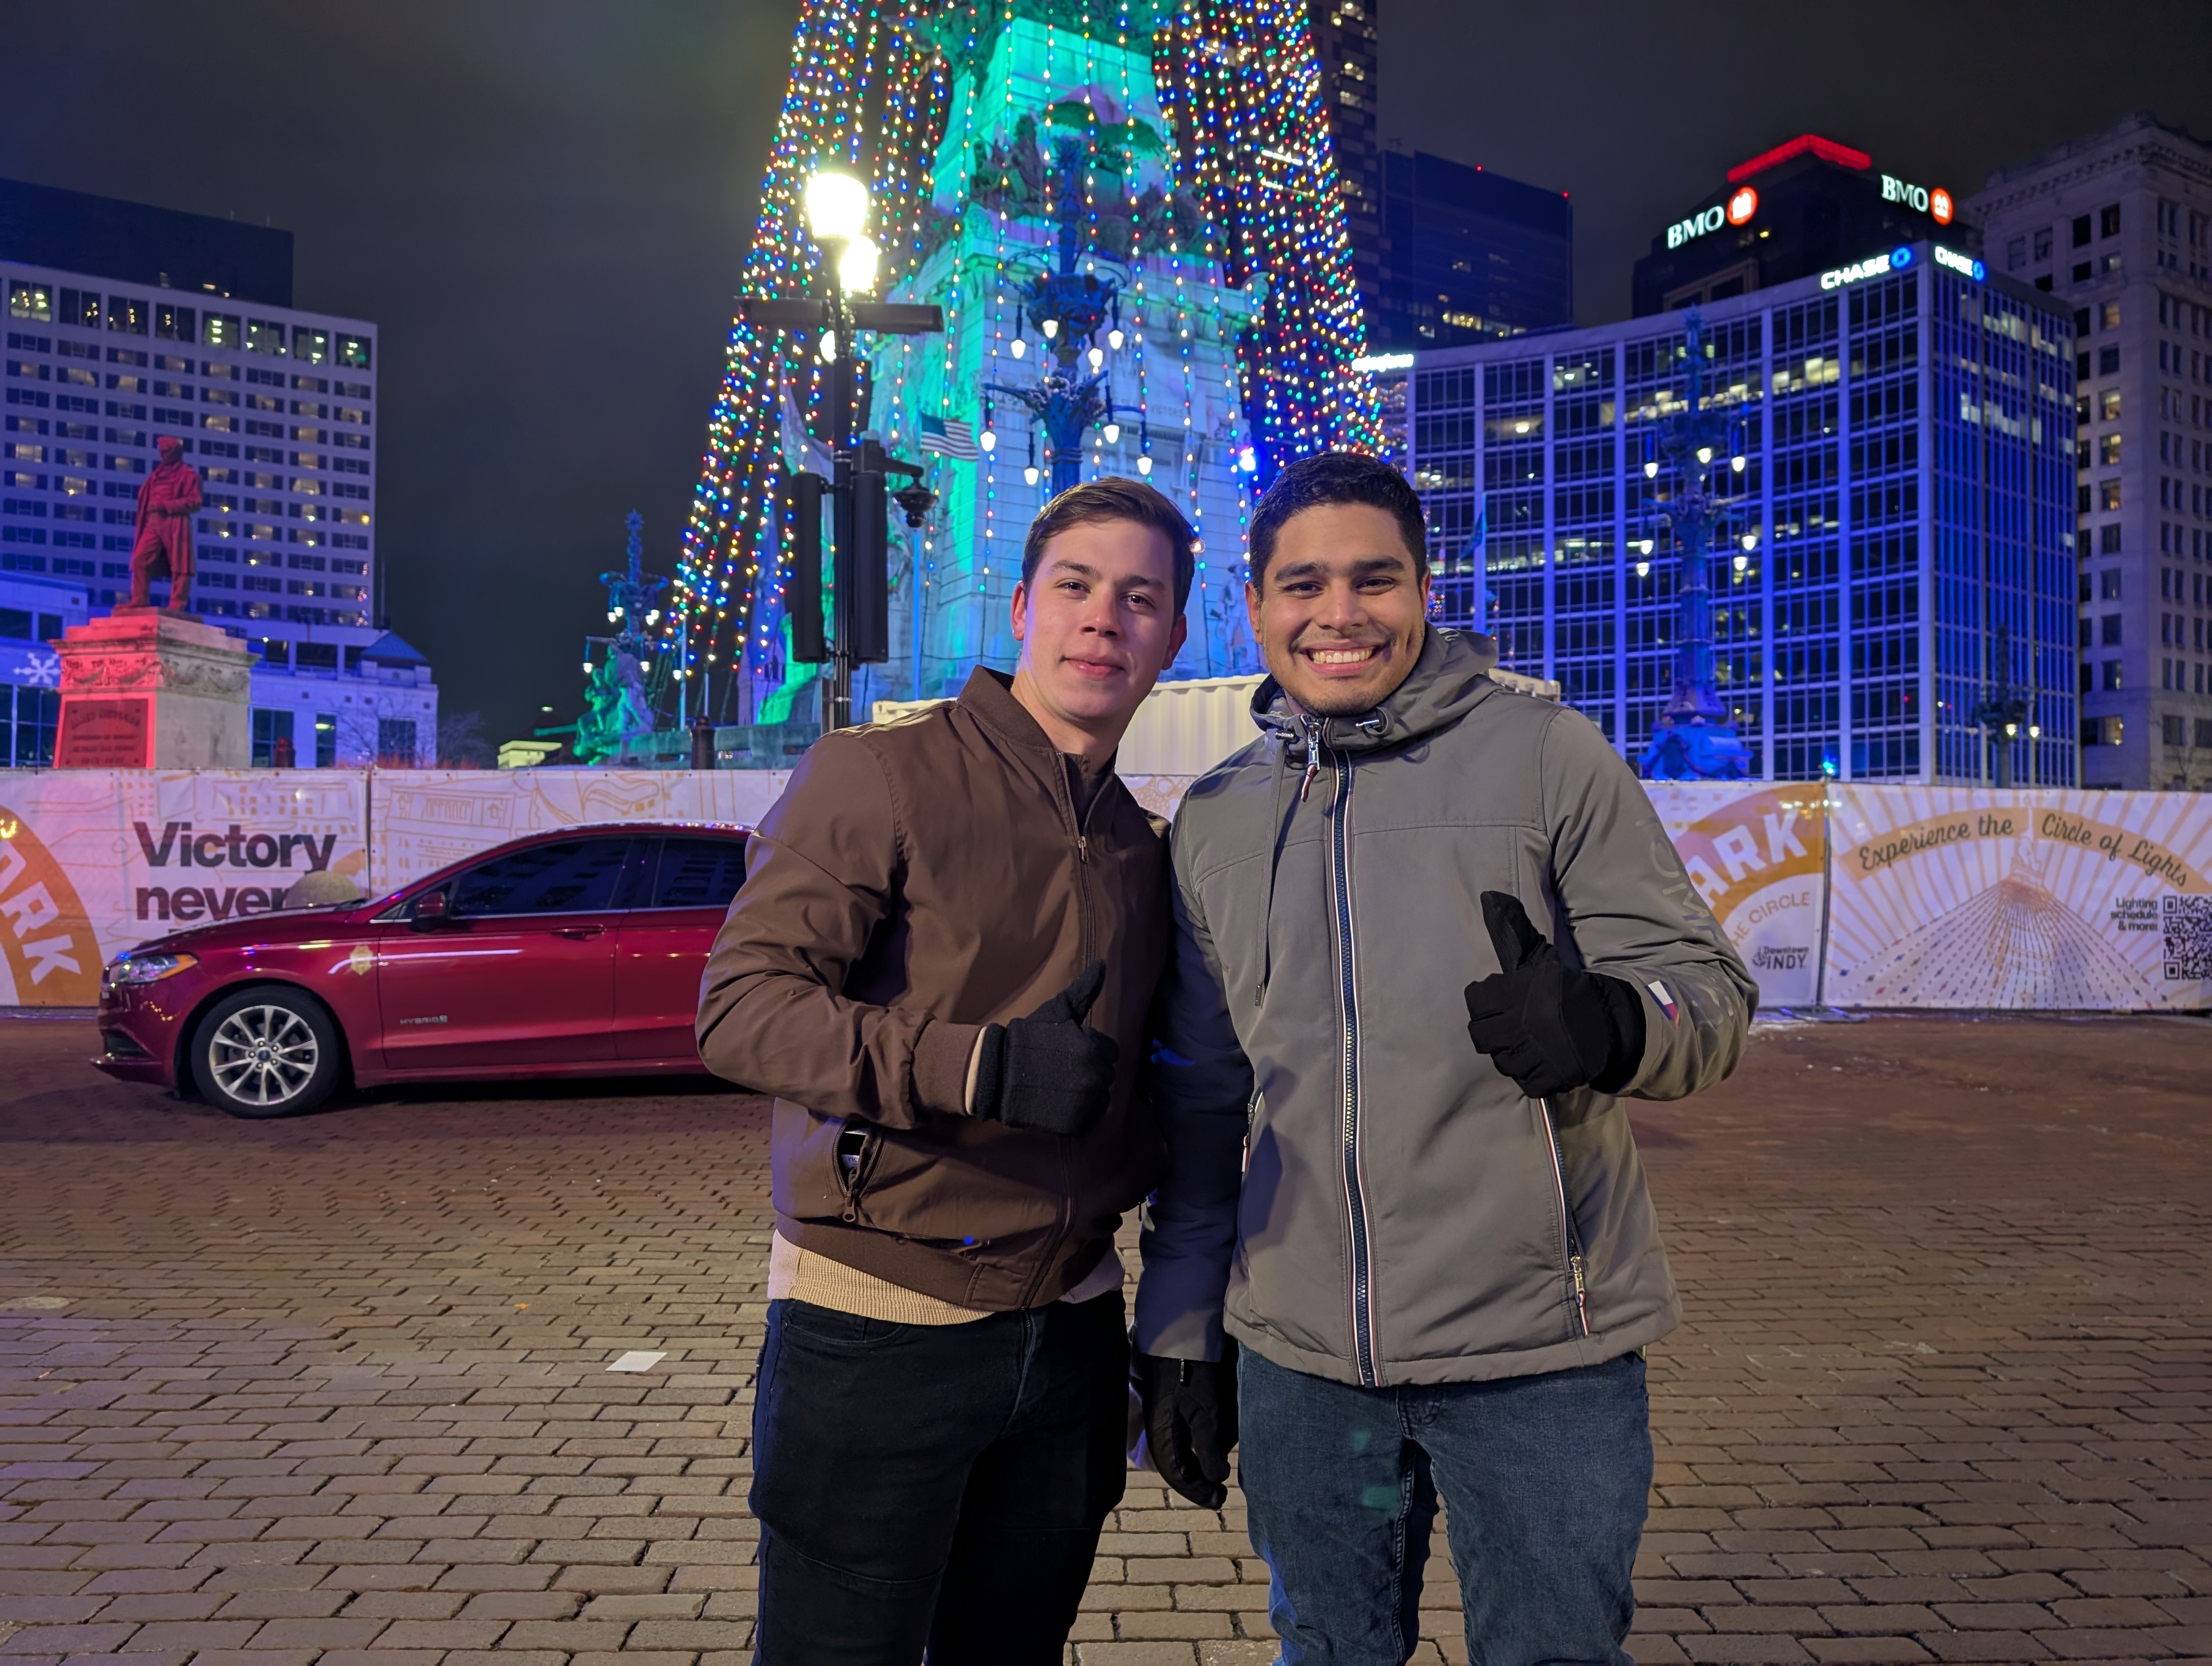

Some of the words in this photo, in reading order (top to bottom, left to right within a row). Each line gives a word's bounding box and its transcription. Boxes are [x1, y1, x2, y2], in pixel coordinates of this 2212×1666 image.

[1881, 174, 1928, 213] BMO
[1667, 205, 1725, 249] BMO
[1821, 254, 1891, 290] CHASE
[1935, 246, 1973, 277] CHASE
[133, 821, 337, 876] Victory
[1860, 821, 1970, 872] Experience
[1978, 814, 2013, 836] the
[2042, 813, 2092, 845] Circle
[2099, 834, 2121, 861] of
[2128, 839, 2188, 888] Lights
[136, 886, 291, 921] never
[1748, 891, 1810, 924] CIRCLE
[2110, 909, 2158, 919] schedule
[2115, 896, 2158, 911] Lighting
[1763, 945, 1809, 954] Downtown
[1767, 953, 1806, 970] INDY
[400, 1016, 439, 1025] HYBRID
